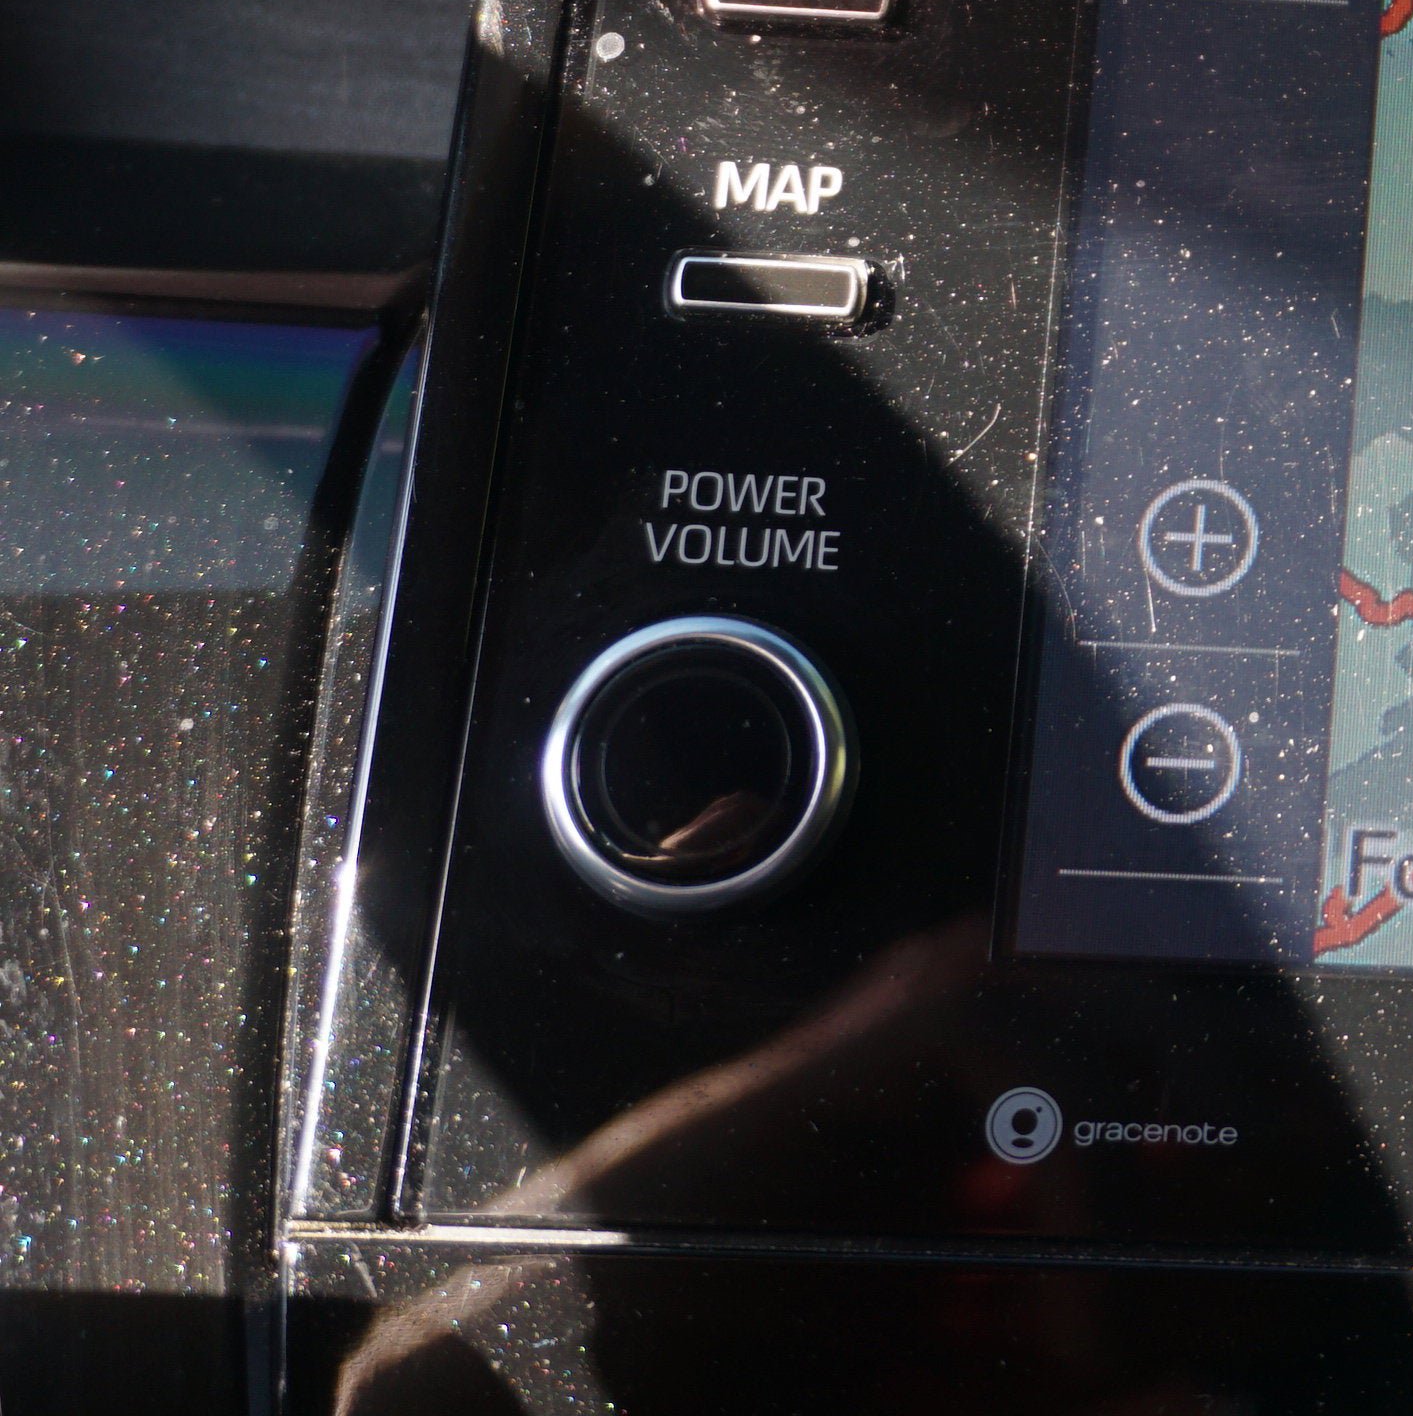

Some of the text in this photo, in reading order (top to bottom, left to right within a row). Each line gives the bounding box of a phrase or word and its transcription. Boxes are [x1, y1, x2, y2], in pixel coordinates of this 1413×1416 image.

[714, 161, 843, 214] MAP
[661, 469, 826, 517] POWER
[644, 523, 841, 570] VOLUME
[1074, 1120, 1238, 1146] gracenote
